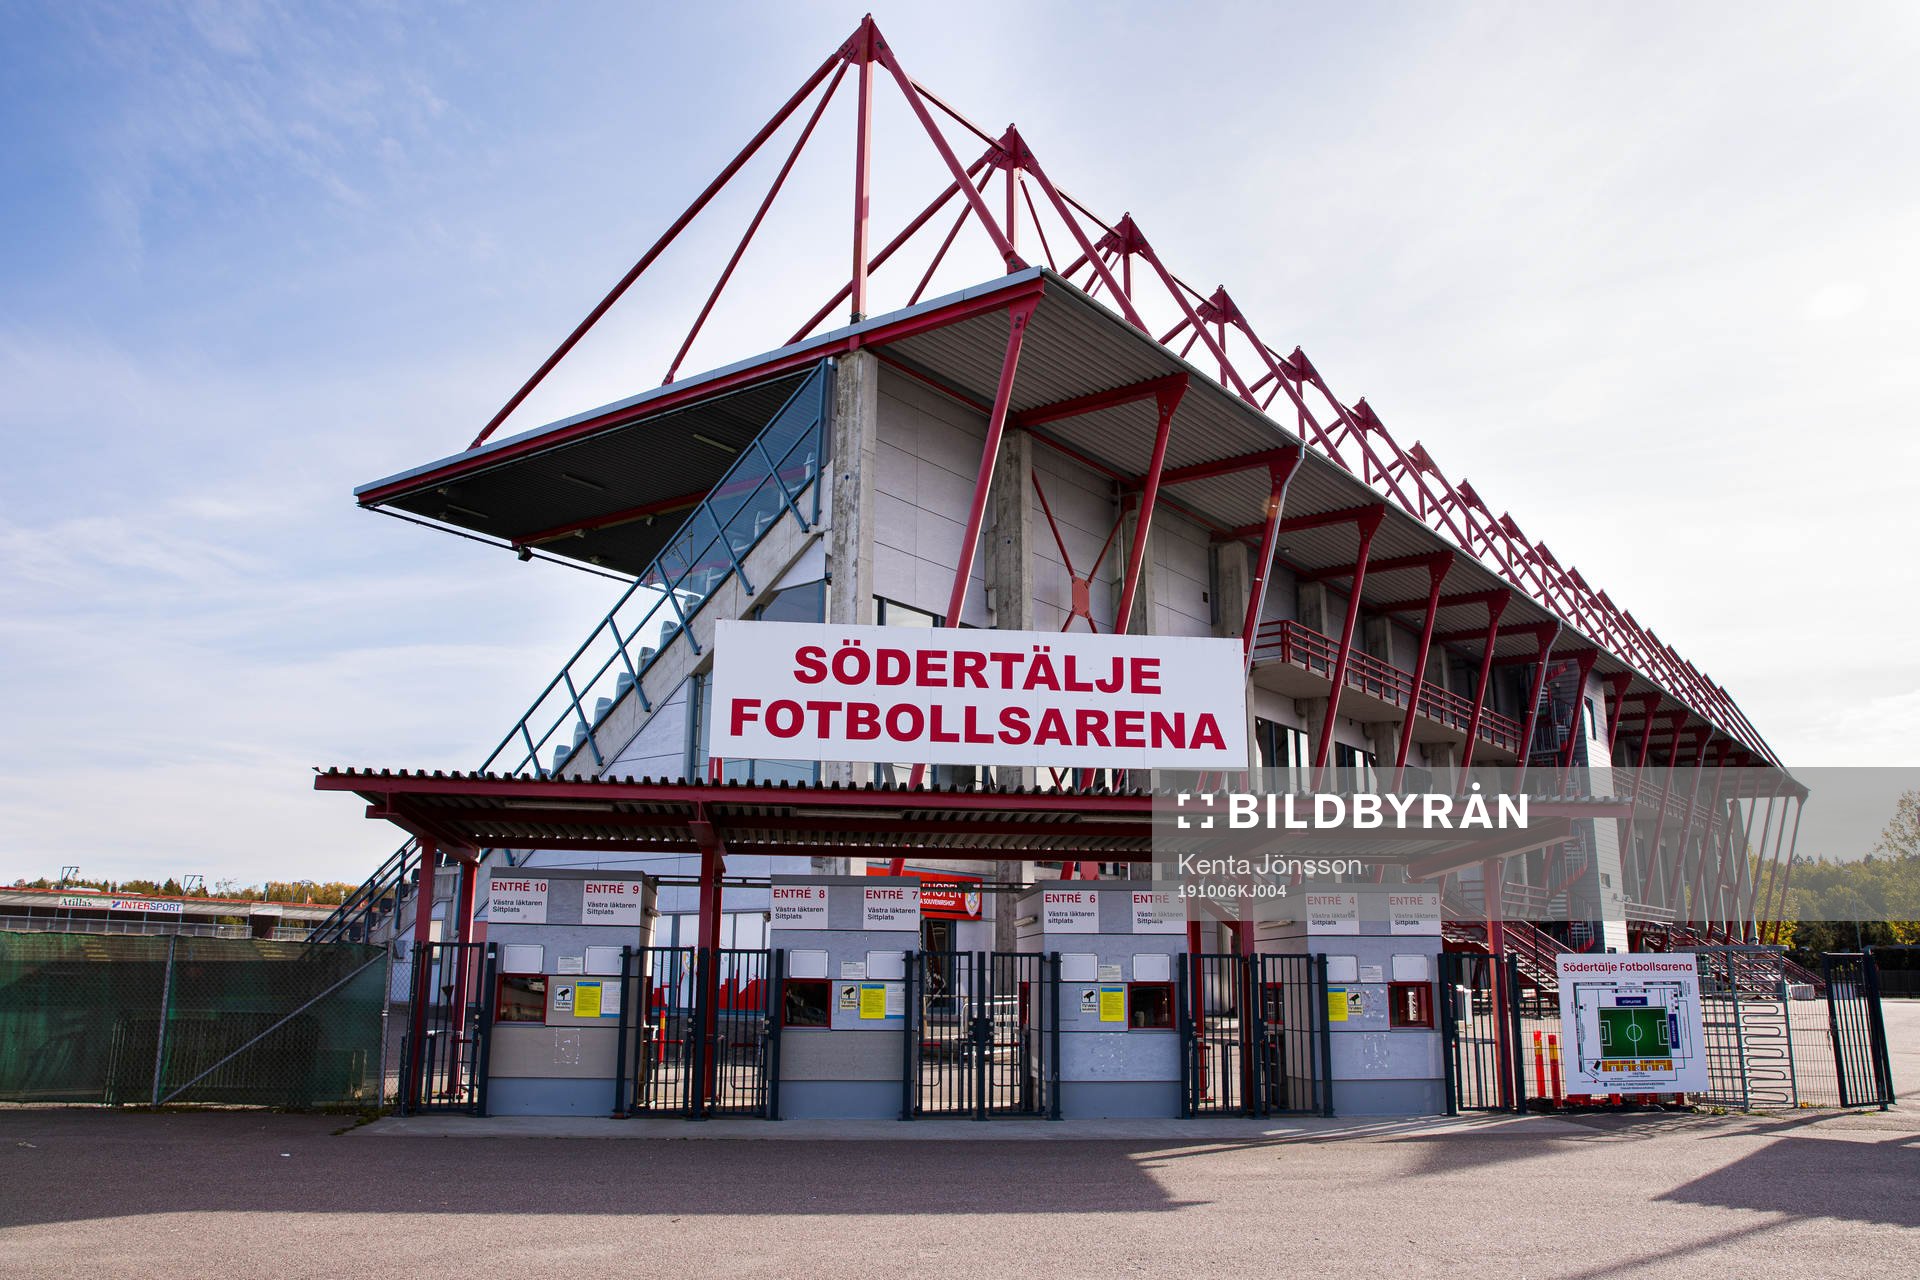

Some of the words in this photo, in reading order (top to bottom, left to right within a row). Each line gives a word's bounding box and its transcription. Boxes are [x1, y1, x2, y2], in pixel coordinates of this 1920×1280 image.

[793, 639, 1162, 695] SÖDERTÄLJE
[730, 698, 1228, 751] FOTBOLLSARENA
[491, 880, 530, 892] ENTRÉ
[534, 882, 546, 892] 10
[586, 883, 624, 894] ENTRÉ
[632, 885, 639, 894] 9
[773, 887, 812, 899] ENTRÉ
[818, 889, 826, 899] 8
[866, 888, 904, 900] ENTRÉ
[912, 891, 918, 900] 7
[1045, 892, 1082, 903] ENTRÉ
[1089, 894, 1096, 903] 6
[1133, 892, 1170, 904] ENTRÉ
[515, 899, 542, 907] läktaren
[1307, 894, 1342, 905] ENTRÉ
[1390, 894, 1424, 905] ENTRÉ
[121, 901, 182, 912] INTERSPORT
[586, 908, 614, 916] Sittplats
[775, 913, 802, 921] Sittplats
[1563, 962, 1617, 974] Södertälje
[1620, 961, 1693, 972] Fotbollsarena
